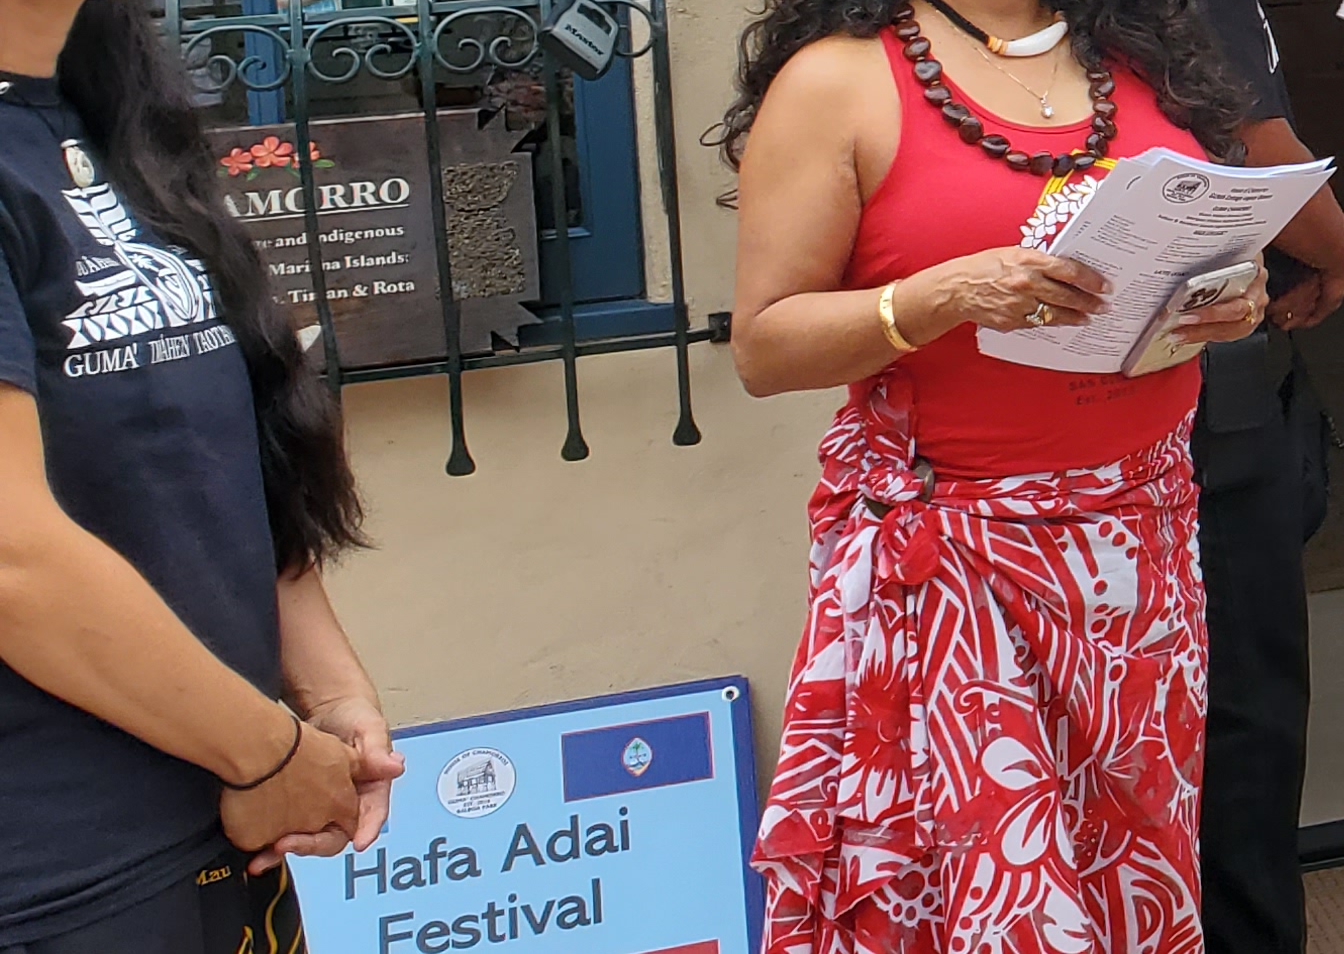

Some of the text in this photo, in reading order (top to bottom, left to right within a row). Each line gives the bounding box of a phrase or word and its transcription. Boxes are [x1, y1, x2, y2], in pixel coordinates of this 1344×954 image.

[275, 233, 307, 248] and
[318, 225, 405, 245] ndigenous
[269, 259, 340, 277] Marina
[352, 284, 369, 297] &
[373, 280, 415, 295] Rota
[344, 806, 631, 901] Hafa Adai
[378, 877, 604, 954] Festival
